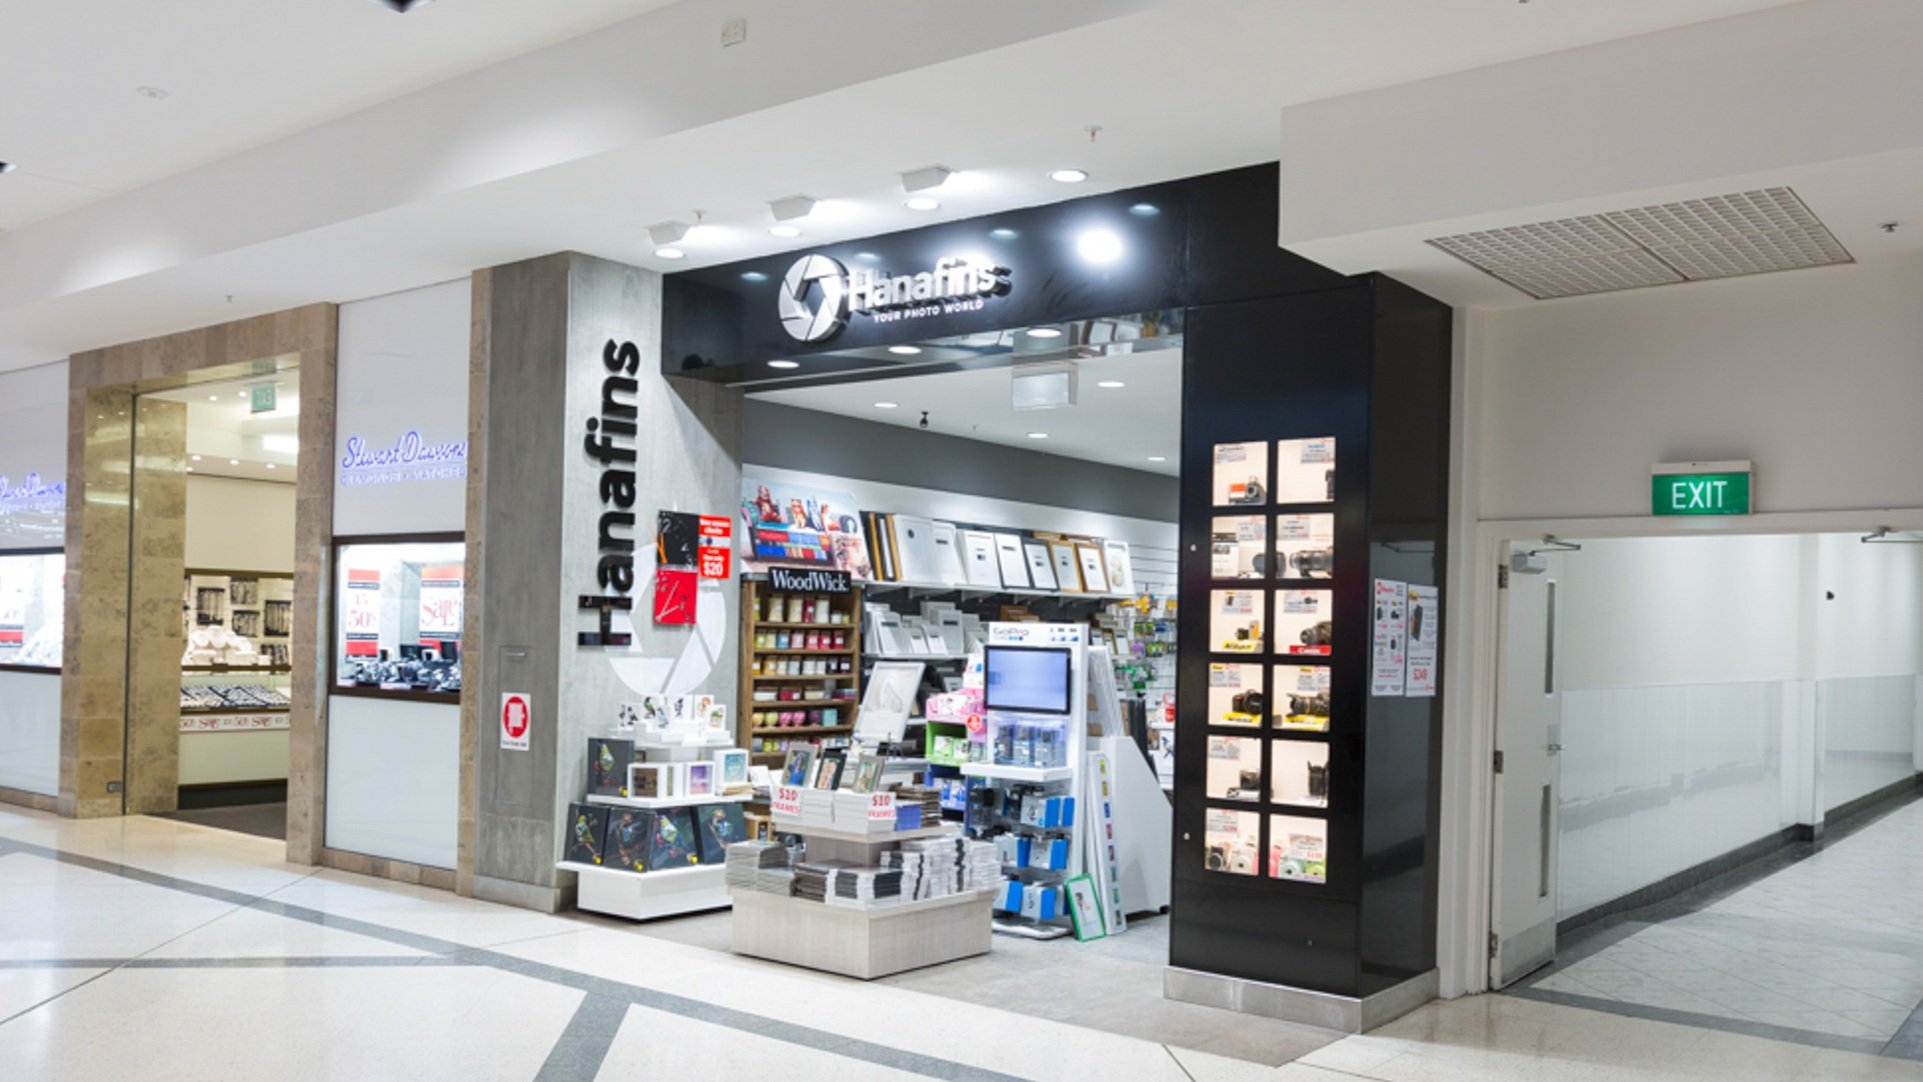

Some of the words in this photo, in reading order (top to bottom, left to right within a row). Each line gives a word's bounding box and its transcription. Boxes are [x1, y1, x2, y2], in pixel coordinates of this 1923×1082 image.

[849, 257, 1000, 312] Hanafins
[874, 311, 901, 323] YOUR
[904, 306, 940, 320] PHOTO
[945, 300, 985, 314] WORLD
[577, 338, 640, 646] Hanafins
[1672, 481, 1728, 509] EXIT
[703, 561, 723, 576] $20
[771, 568, 848, 591] WoodWick
[993, 626, 1030, 637] GoPro
[872, 794, 891, 807] $10
